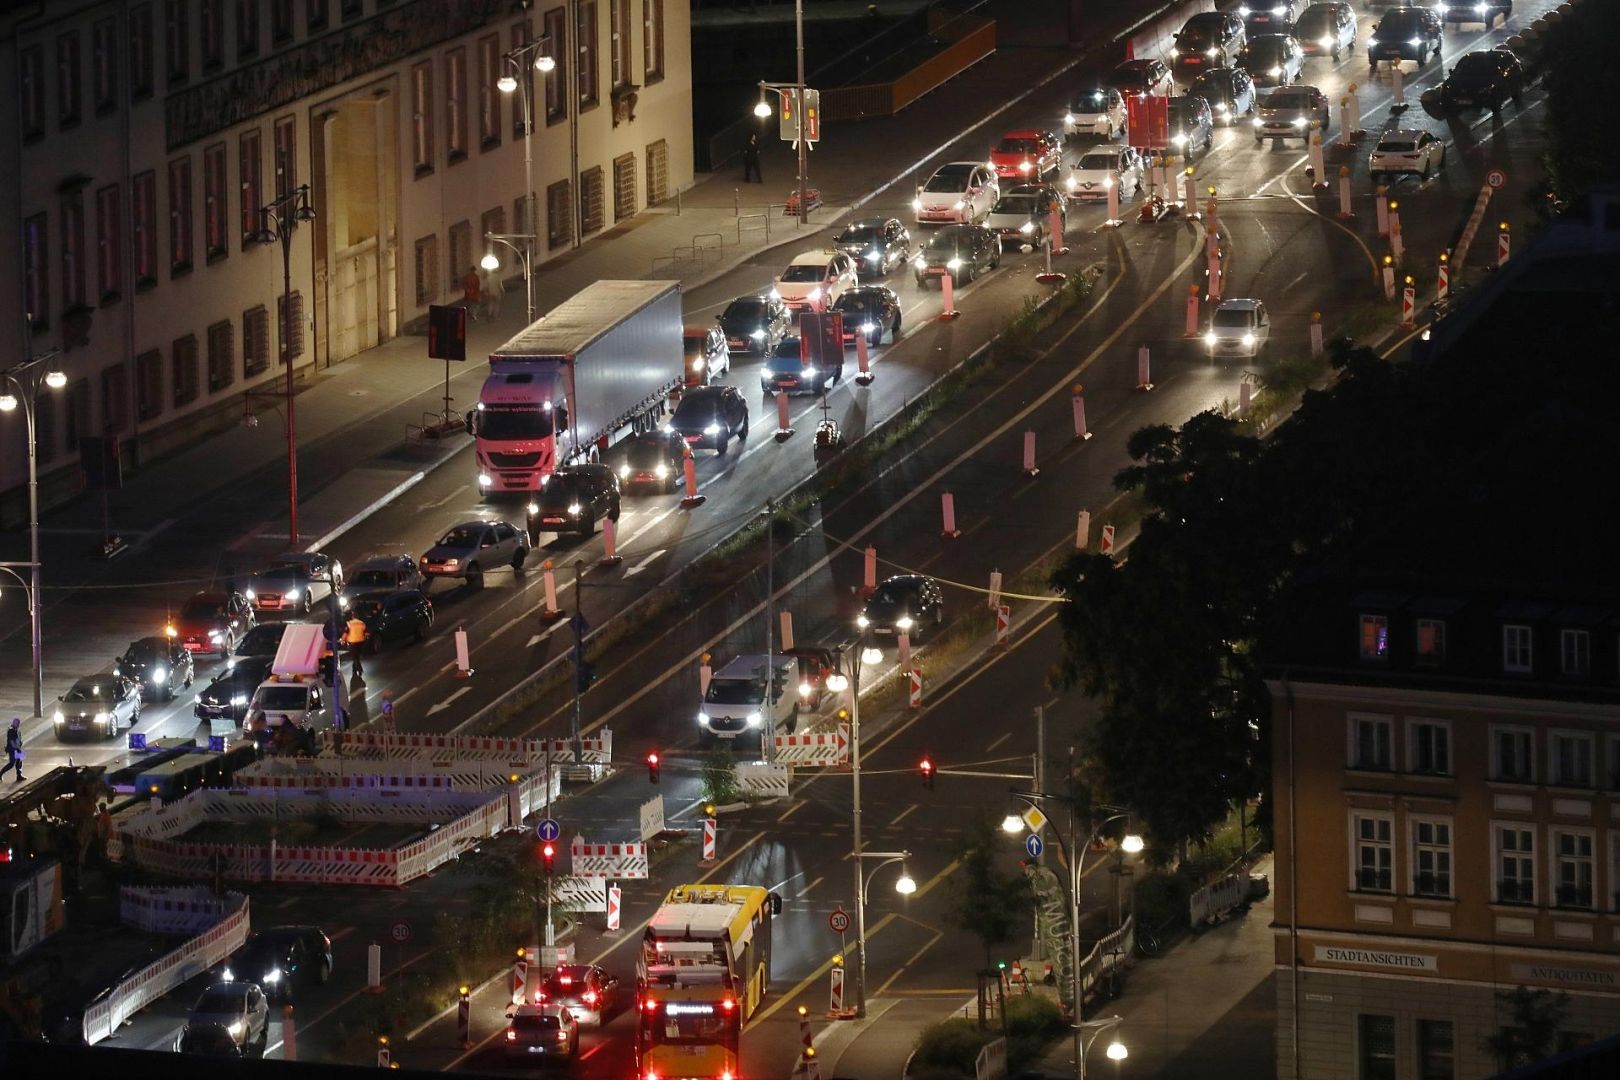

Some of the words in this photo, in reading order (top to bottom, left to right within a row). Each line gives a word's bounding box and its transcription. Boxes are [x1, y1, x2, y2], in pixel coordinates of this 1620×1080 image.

[834, 916, 846, 927] 30
[394, 927, 408, 937] 30
[1327, 949, 1425, 967] STADTANSICHTEN
